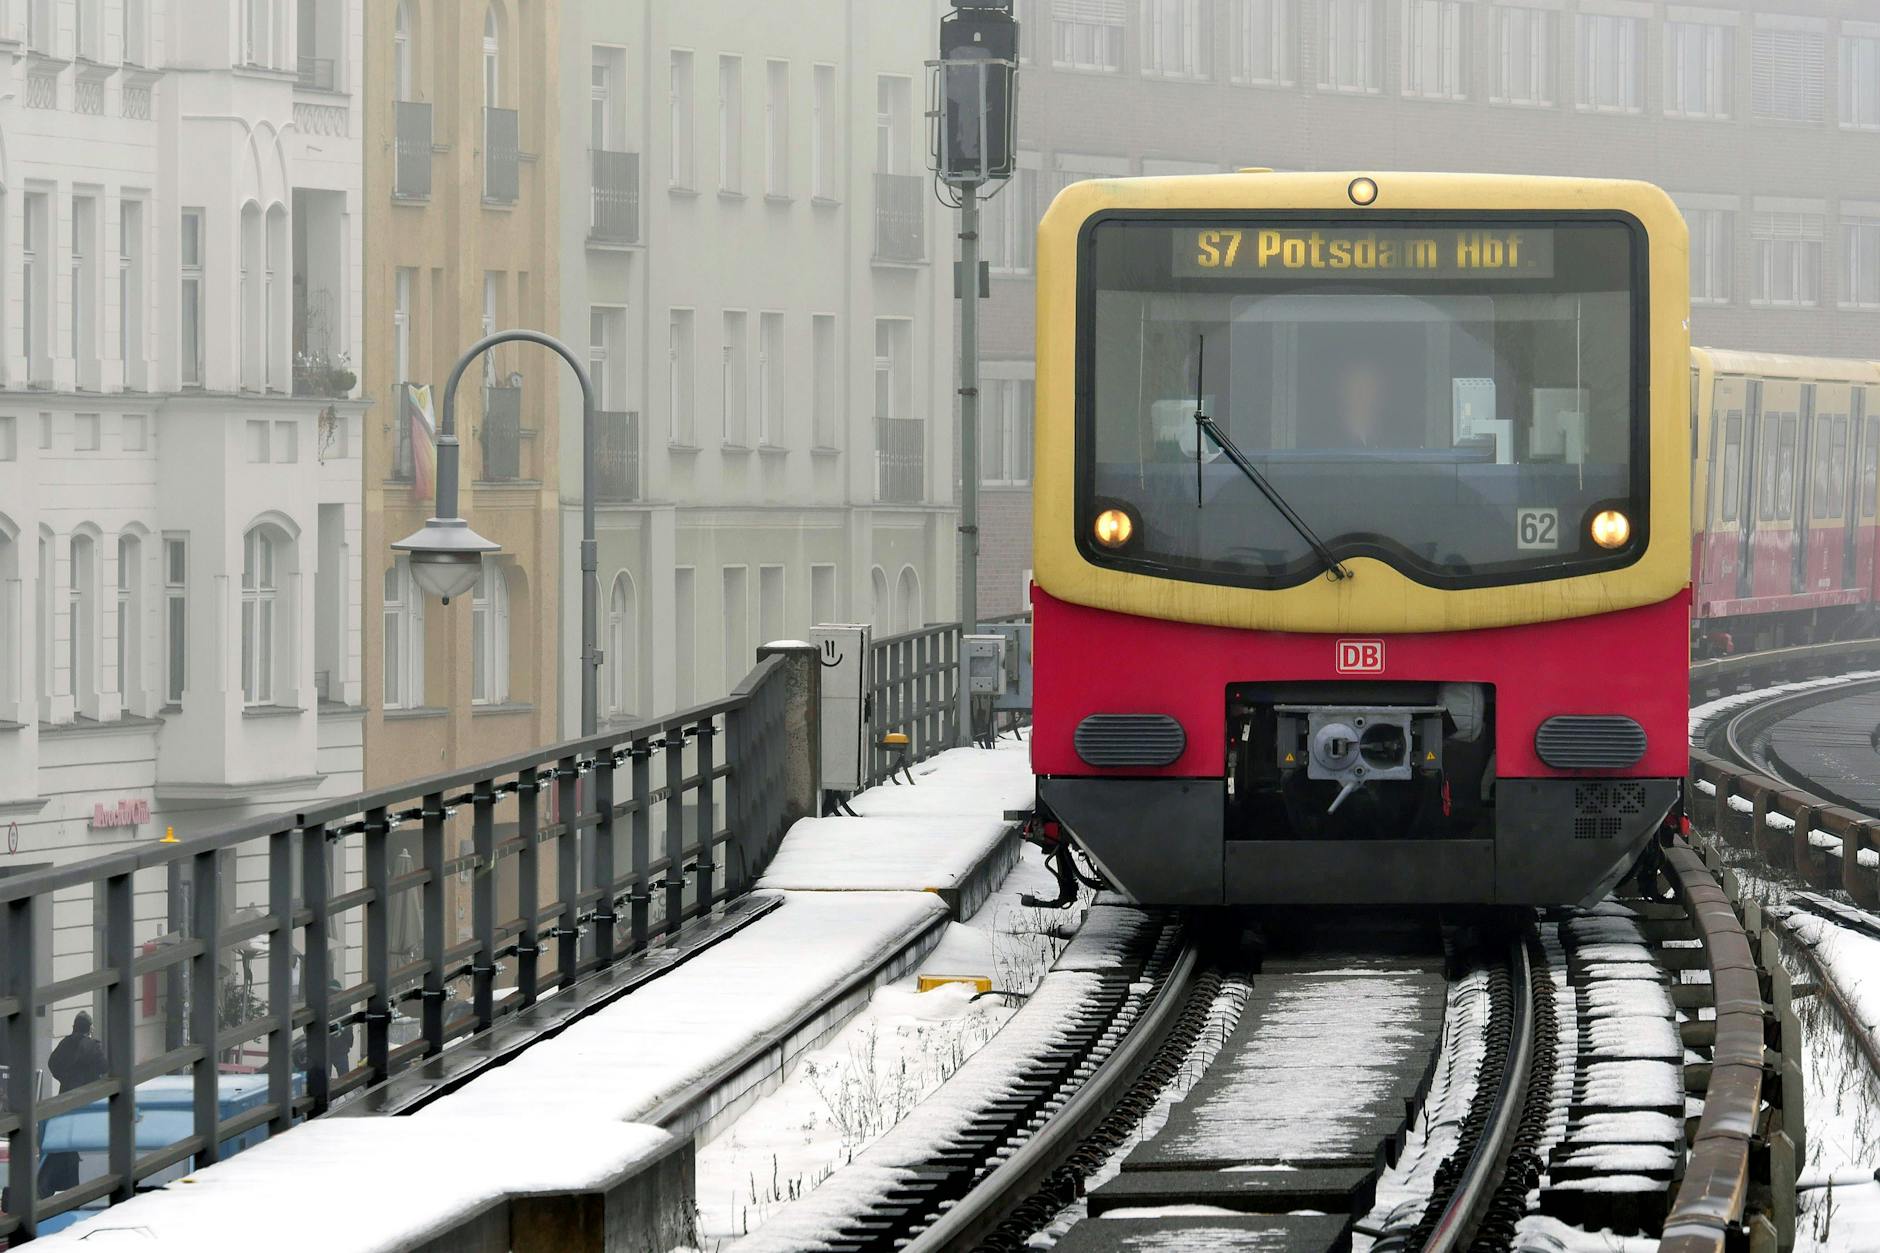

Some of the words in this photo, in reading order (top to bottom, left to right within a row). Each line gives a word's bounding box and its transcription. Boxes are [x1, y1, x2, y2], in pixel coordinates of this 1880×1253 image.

[1198, 230, 1242, 268] S7
[1258, 229, 1437, 269] Potsdam
[1520, 512, 1556, 544] 62
[1343, 645, 1379, 667] DB
